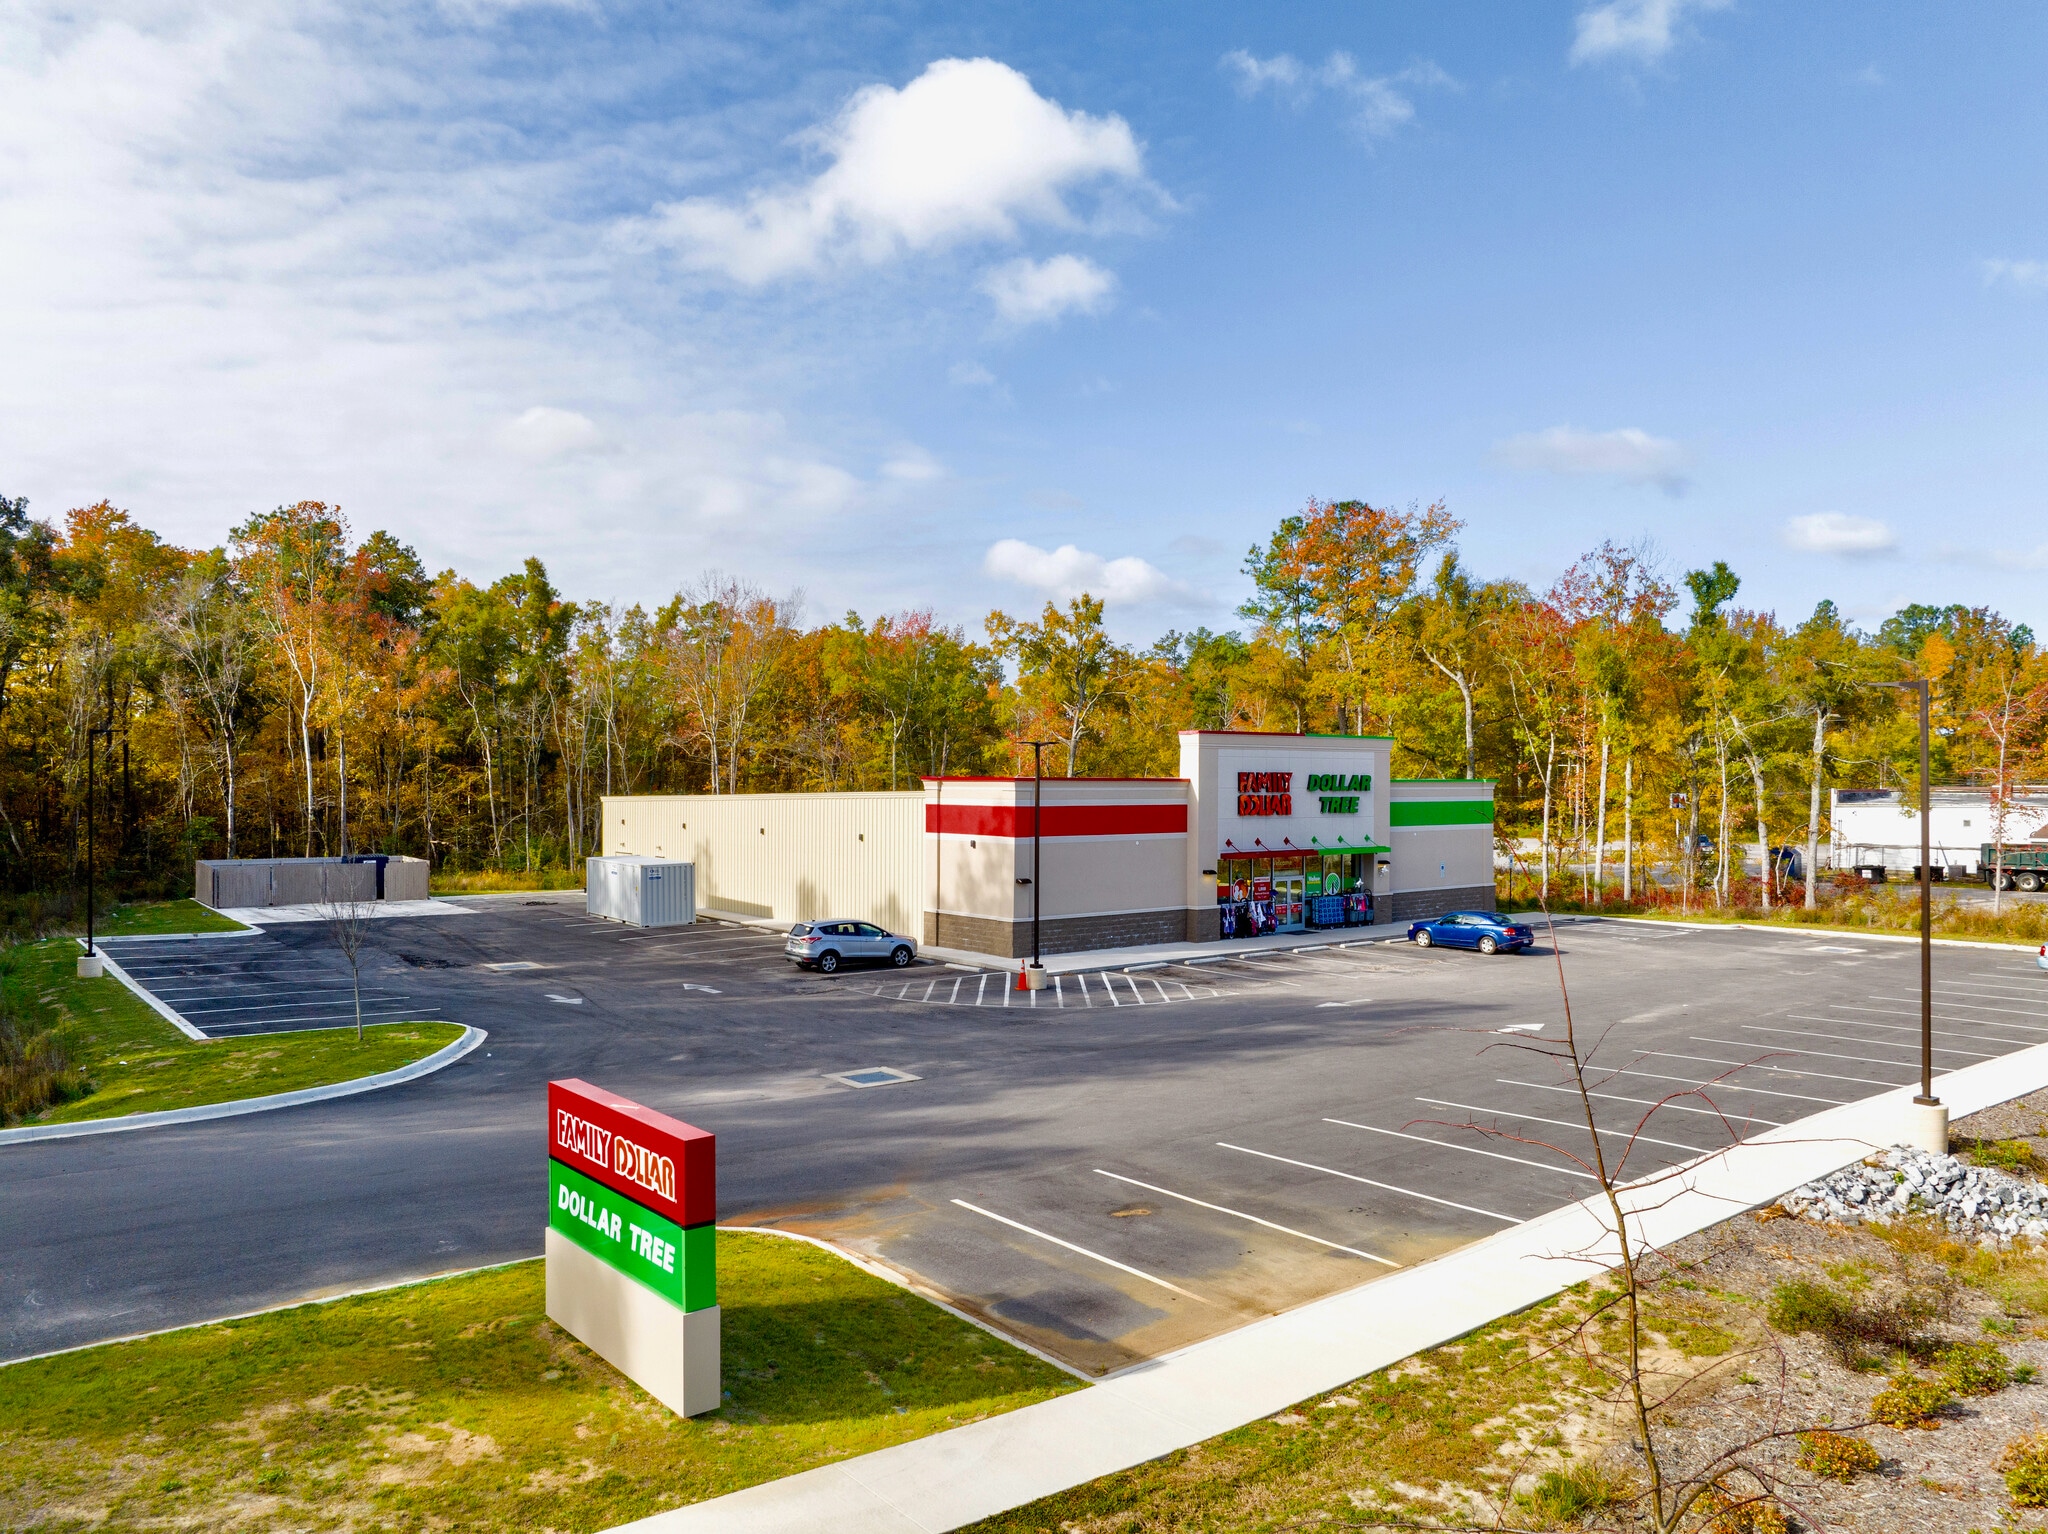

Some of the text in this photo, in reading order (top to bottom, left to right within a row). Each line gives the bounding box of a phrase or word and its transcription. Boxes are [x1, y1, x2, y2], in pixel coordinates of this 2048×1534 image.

[1238, 772, 1292, 792] FAMILY
[1307, 774, 1371, 791] DOLLAR
[1238, 794, 1292, 815] DOLLAR
[1319, 797, 1359, 813] TREE
[557, 1108, 676, 1203] FAMILY DOLLAR
[558, 1183, 676, 1275] DOLLAR TREE
